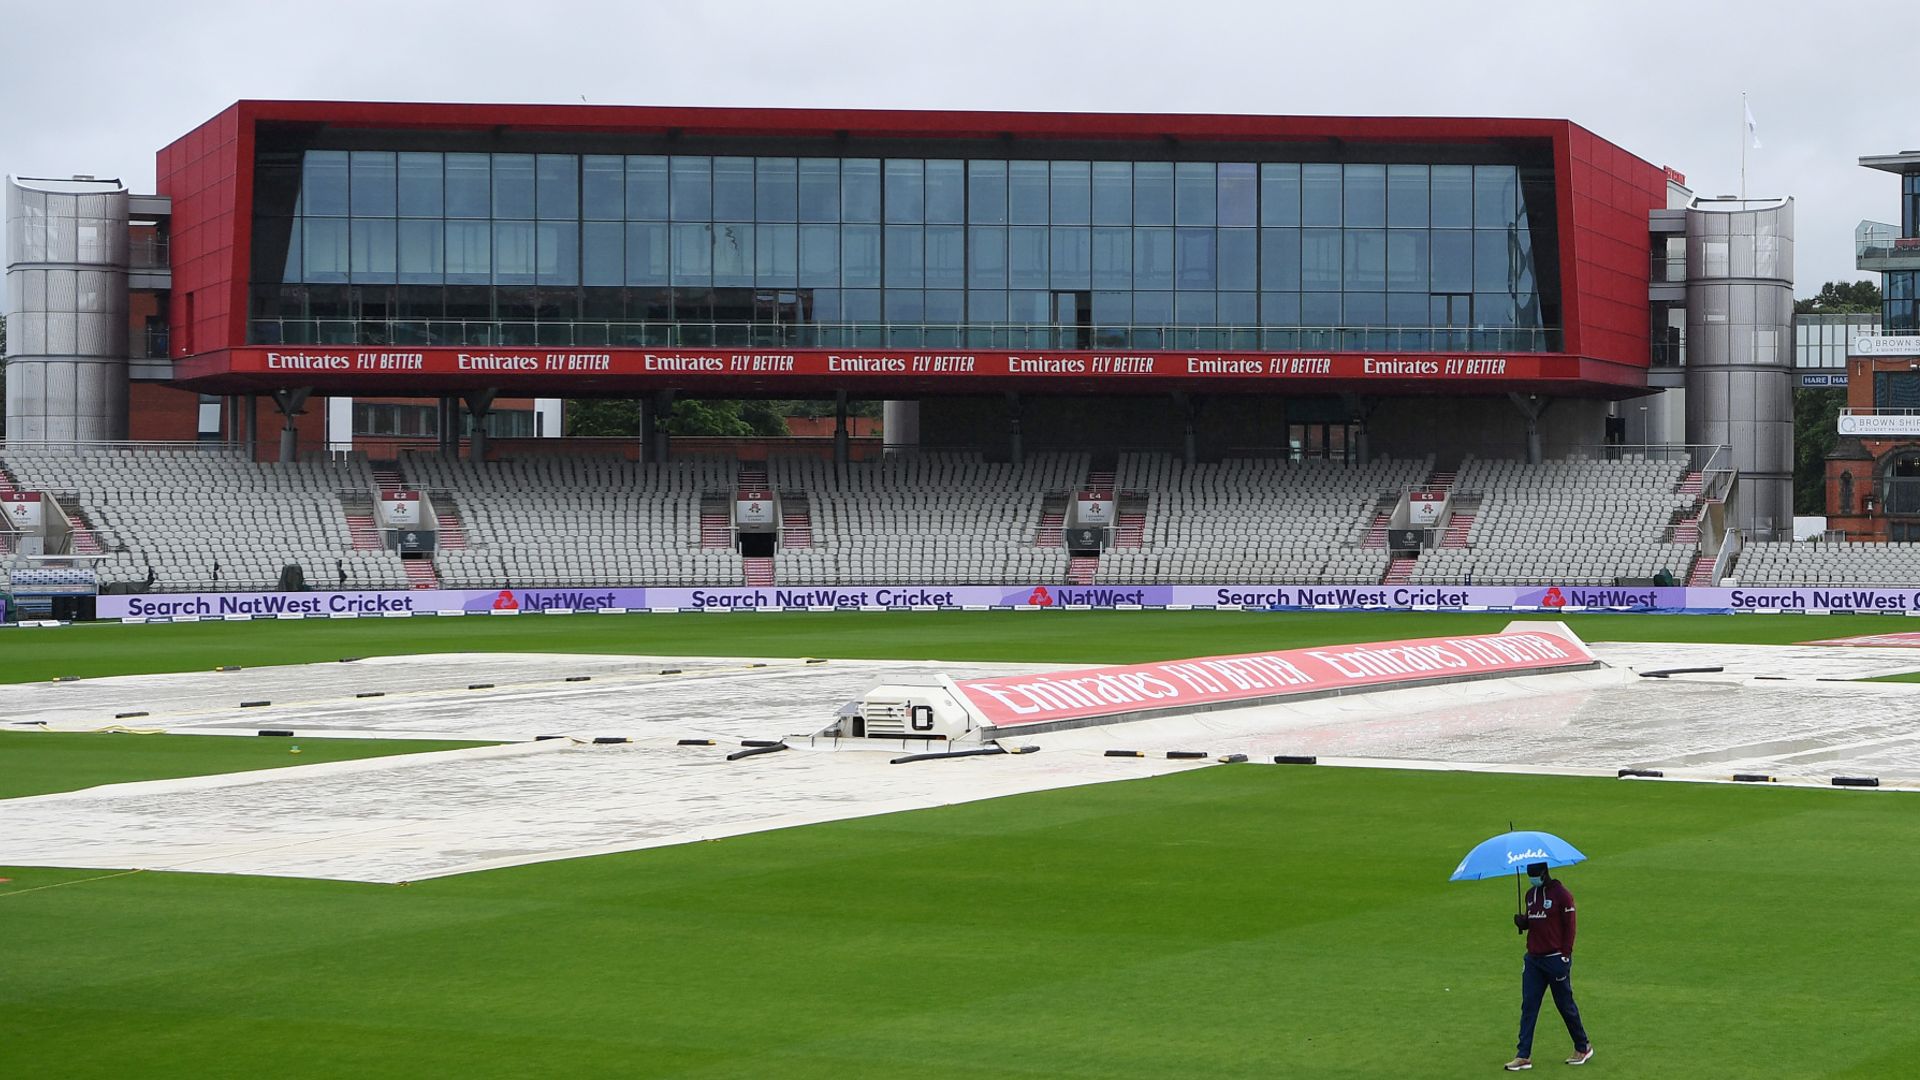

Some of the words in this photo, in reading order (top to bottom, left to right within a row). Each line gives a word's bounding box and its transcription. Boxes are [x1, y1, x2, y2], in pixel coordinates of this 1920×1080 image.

[1876, 339, 1911, 347] BROWN
[268, 353, 349, 369] Emirates
[357, 354, 377, 369] FLY
[380, 354, 423, 369] BETTER
[458, 354, 538, 370] Emirates
[546, 355, 566, 370] FLY
[569, 355, 610, 370] BETTER
[645, 355, 723, 370] Emirates
[731, 356, 750, 371] FLY
[753, 356, 794, 371] BETTER
[829, 356, 905, 371] Emirates
[913, 357, 932, 371] FLY
[935, 357, 975, 371] BETTER
[1009, 357, 1085, 372] Emirates
[1092, 357, 1110, 372] FLY
[1114, 357, 1154, 372] BETTER
[1188, 358, 1263, 373] Emirates
[1270, 359, 1288, 373] FLY
[1292, 359, 1330, 373] BETTER
[1364, 359, 1438, 374] Emirates
[1445, 360, 1464, 374] FLY
[1467, 360, 1506, 374] BETTER
[524, 592, 616, 610] NatWest
[692, 591, 768, 609] Search
[776, 591, 868, 608] NatWest
[876, 589, 953, 607] Cricket
[1058, 590, 1144, 607] NatWest
[1217, 589, 1289, 606] Search
[1297, 589, 1386, 606] NatWest
[1393, 588, 1469, 606] Cricket
[1571, 590, 1657, 607] NatWest
[1731, 591, 1805, 608] Search
[1813, 591, 1906, 609] NatWest
[129, 597, 211, 617] Search
[220, 596, 320, 615] NatWest
[329, 594, 414, 614] Cricket
[1305, 640, 1467, 678] Emirates
[1445, 637, 1504, 666] FLY
[1484, 634, 1569, 665] BETTER
[966, 671, 1180, 714] Emirates
[1158, 661, 1228, 694] FLY
[1200, 656, 1315, 690] BETTER
[1507, 848, 1549, 864] Sandals
